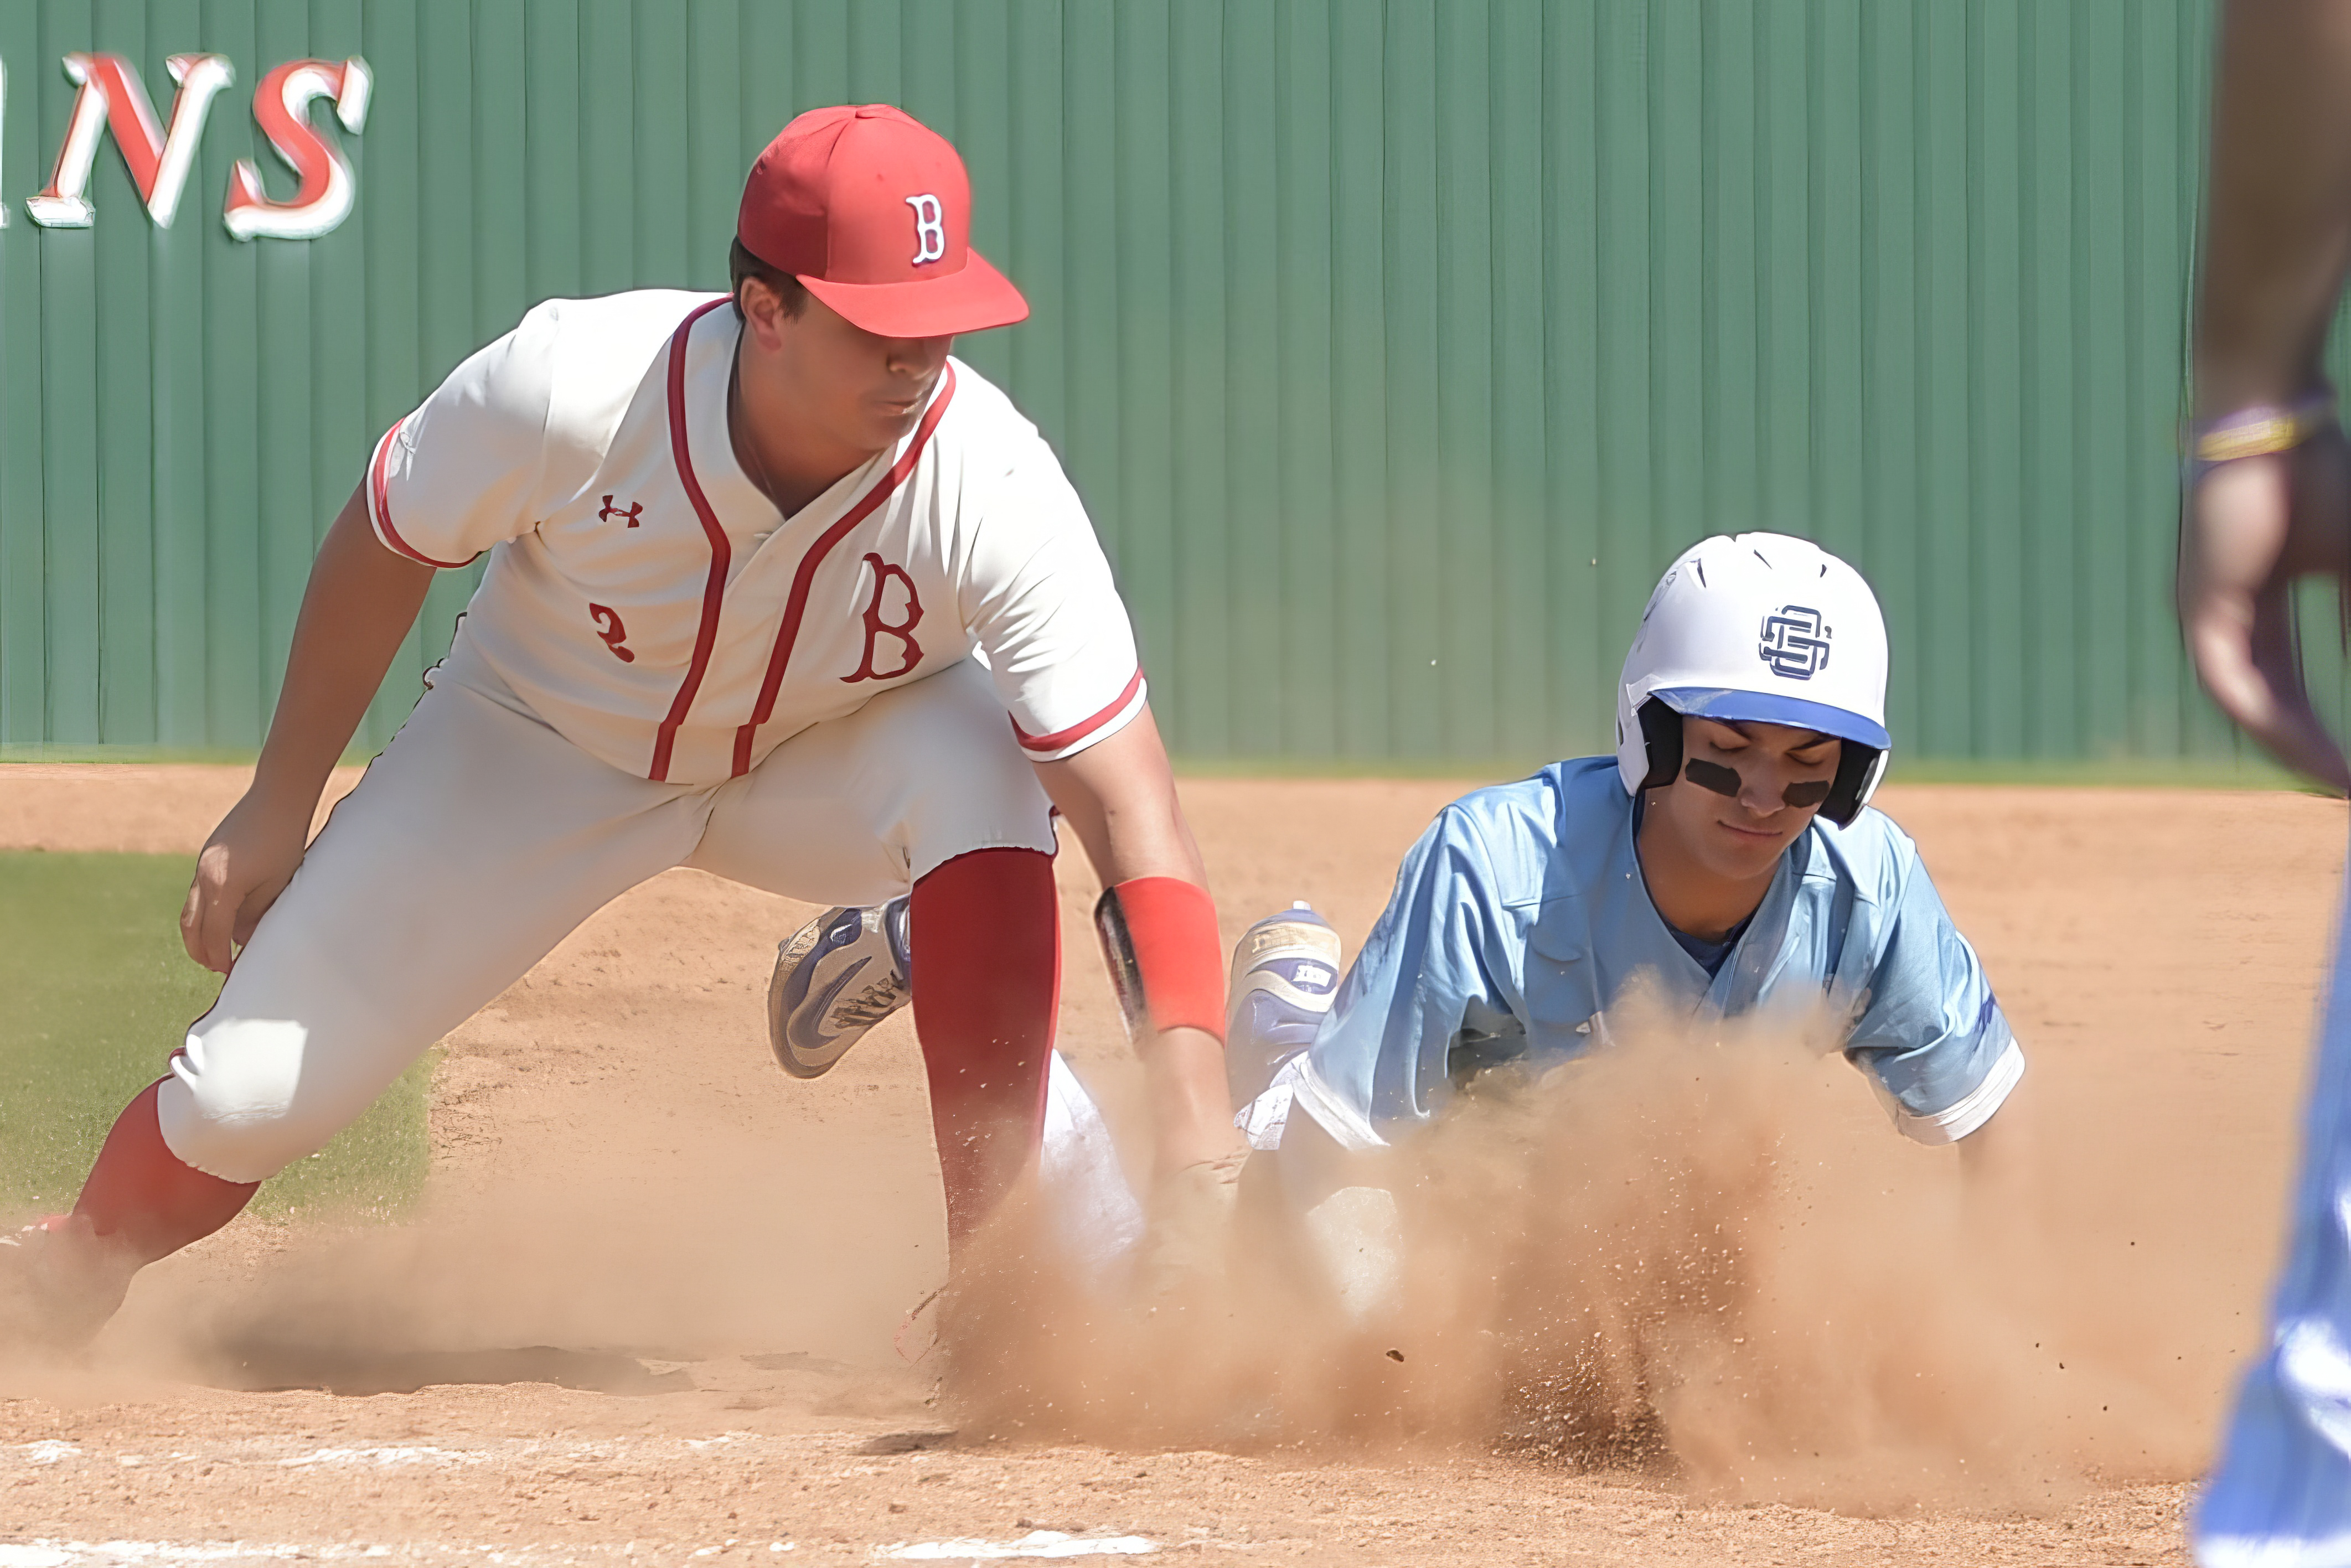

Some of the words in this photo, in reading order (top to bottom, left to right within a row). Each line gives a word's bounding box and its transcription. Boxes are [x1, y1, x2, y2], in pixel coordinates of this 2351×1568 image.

[0, 51, 373, 242] NS
[905, 194, 945, 265] B
[839, 552, 924, 684] B
